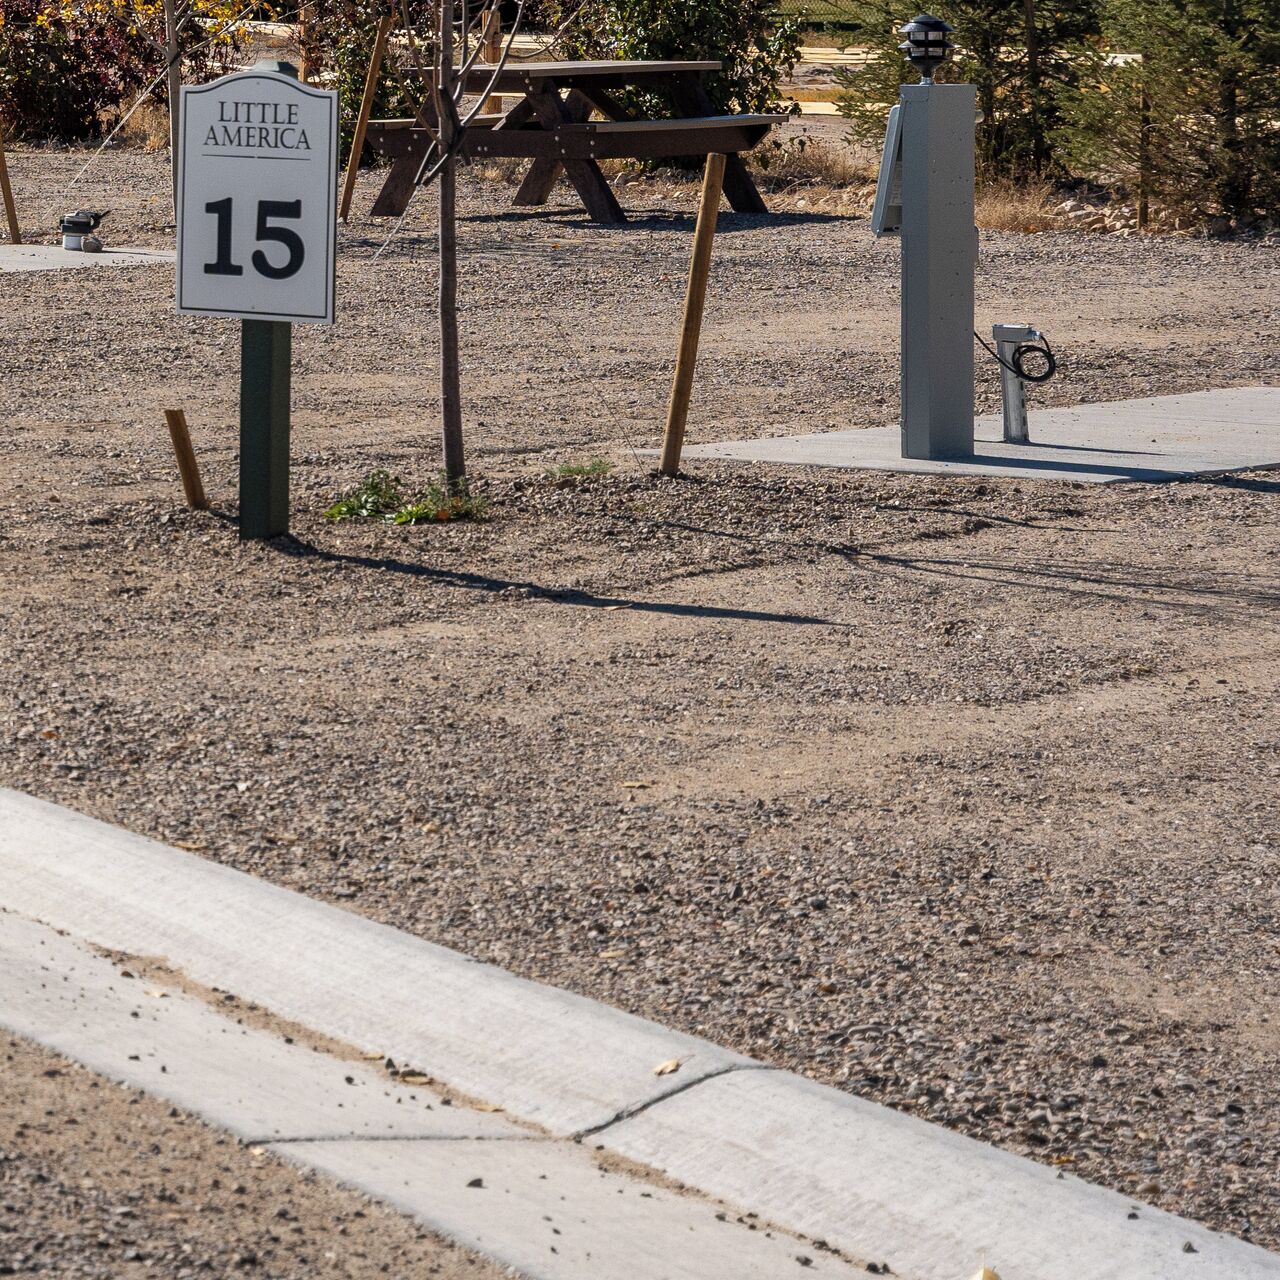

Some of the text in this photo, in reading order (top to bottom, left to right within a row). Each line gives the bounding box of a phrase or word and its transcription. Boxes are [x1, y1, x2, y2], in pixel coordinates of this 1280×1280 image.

[218, 101, 299, 125] LITTLE
[203, 125, 312, 150] AMERICA
[203, 197, 305, 280] 15
